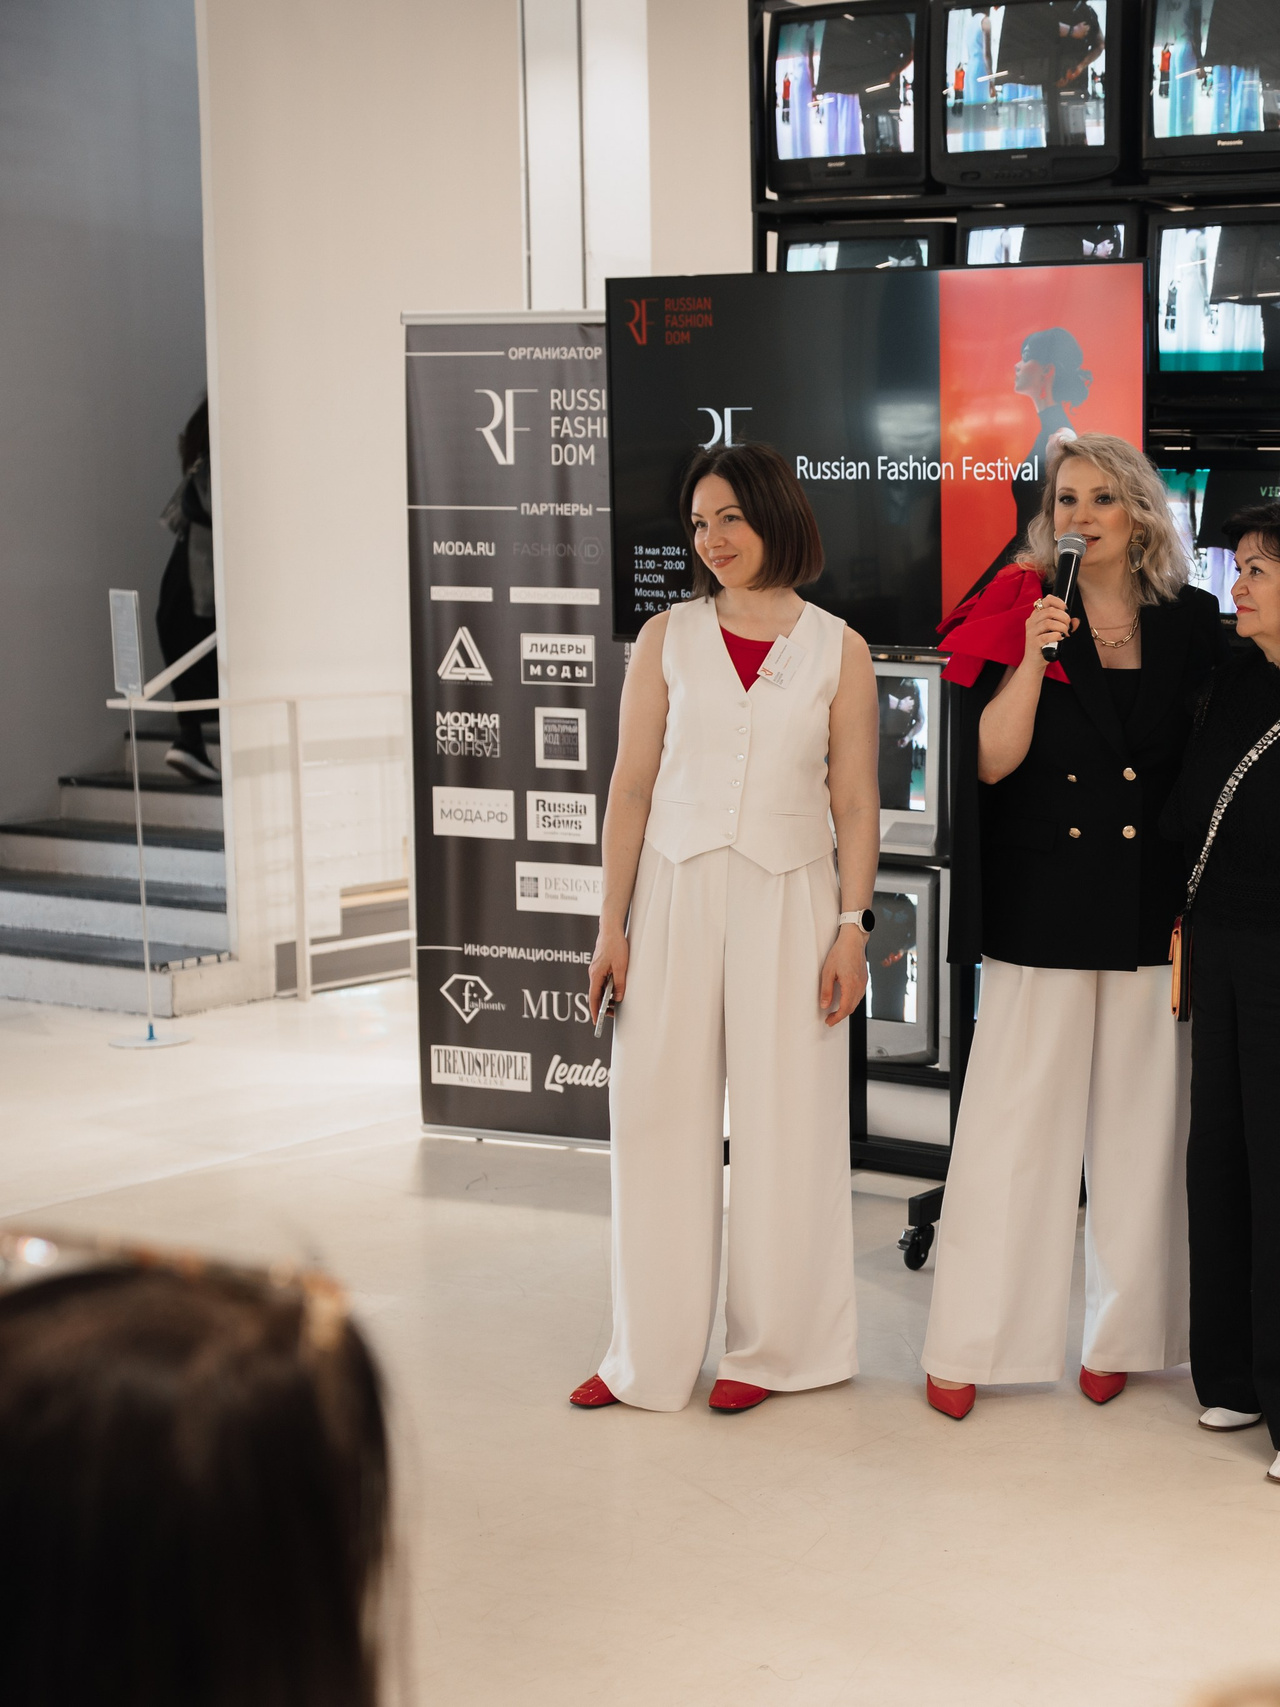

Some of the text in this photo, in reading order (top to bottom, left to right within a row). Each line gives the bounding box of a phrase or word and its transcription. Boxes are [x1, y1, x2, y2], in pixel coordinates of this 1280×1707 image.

[664, 297, 712, 312] RUSSIAN
[664, 313, 713, 329] FASHION
[665, 330, 691, 346] DOM
[508, 346, 603, 361] ОРГАНИЗАТОР
[550, 388, 606, 411] RUSSI
[551, 416, 607, 439] FASHI
[551, 443, 595, 466] DOM
[796, 454, 1039, 481] Russian Fashion Festival
[520, 502, 593, 517] ПАРТНЕРЫ
[433, 541, 496, 557] MODA.RU
[634, 546, 688, 556] 18 мая 2024 г.
[634, 560, 655, 570] 11:00
[663, 560, 685, 570] 20:00
[634, 574, 665, 584] FLACON
[634, 588, 666, 599] Москва,
[644, 602, 656, 613] 36,
[529, 643, 586, 656] ЛИДЕРЫ
[529, 664, 588, 679] МОДЫ
[436, 726, 474, 742] СЕТЬ
[543, 733, 560, 746] КОД
[440, 807, 508, 824] МОДА.РФ
[535, 799, 587, 816] Russia
[541, 815, 582, 831] Sews
[464, 943, 591, 965] ИНФОРМАЦИОННЫЕ
[521, 988, 591, 1024] MUS
[434, 1048, 529, 1081] TRENDSPEOPLE
